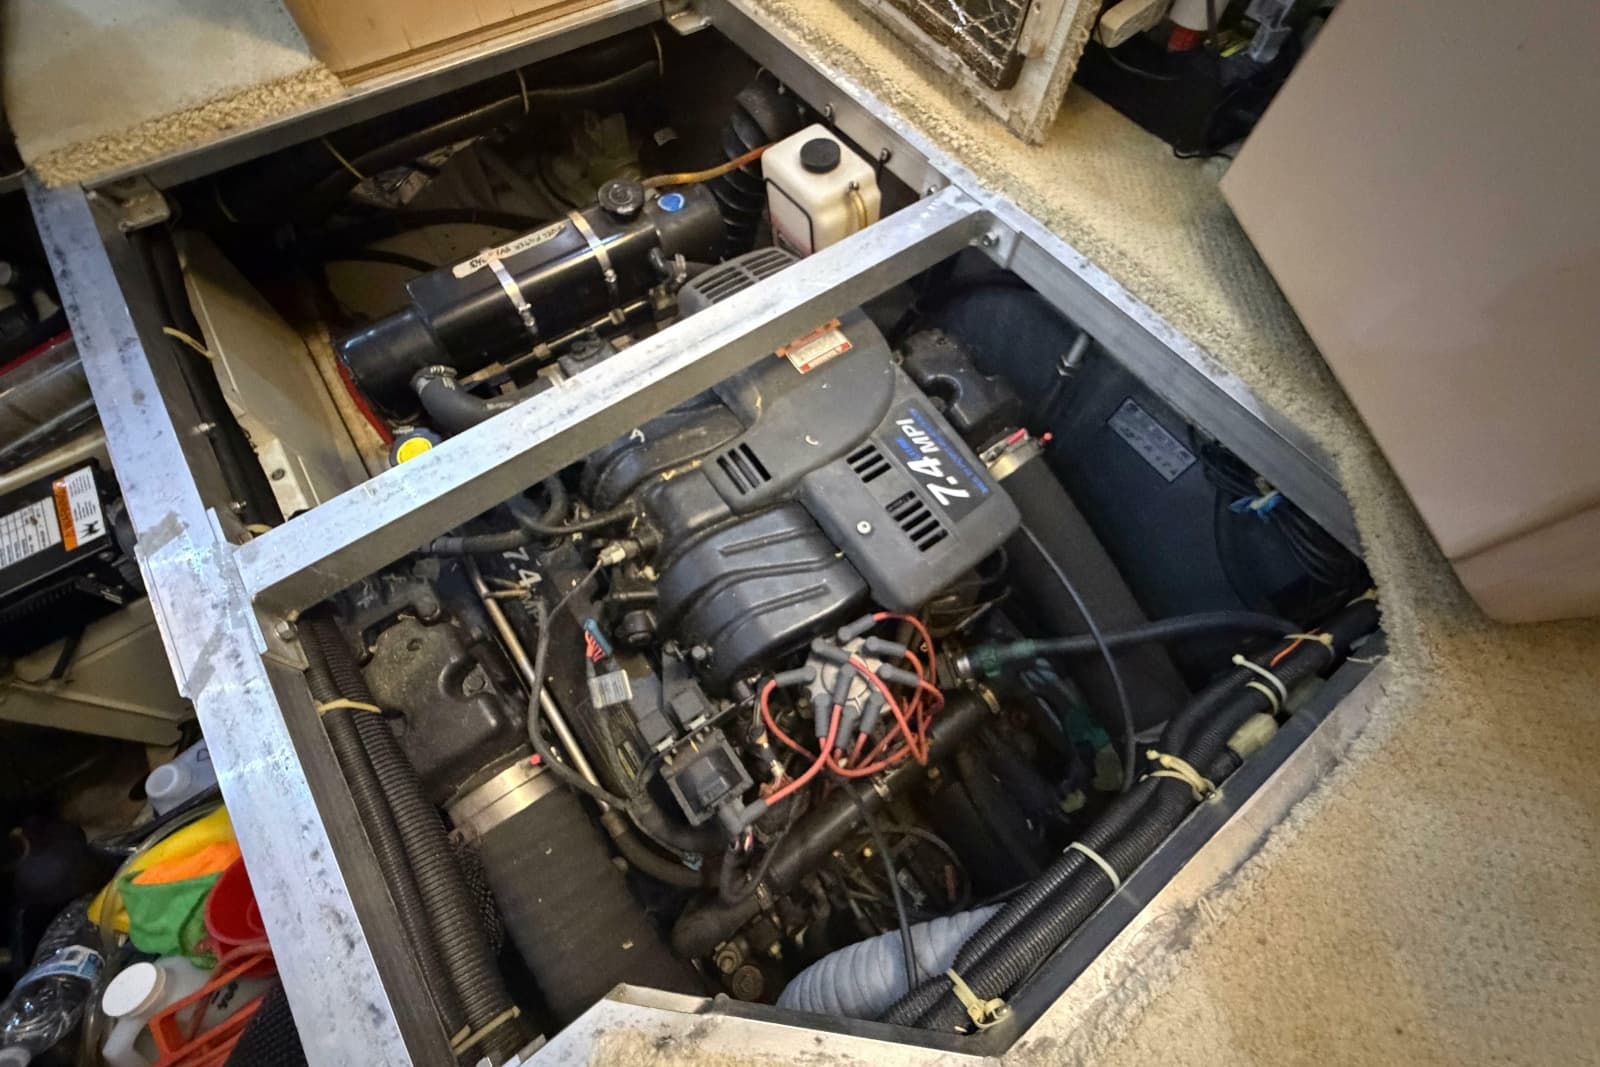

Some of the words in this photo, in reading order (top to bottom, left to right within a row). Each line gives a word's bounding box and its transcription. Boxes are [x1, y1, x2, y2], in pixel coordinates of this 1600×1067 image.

[895, 418, 940, 453] MPI
[906, 455, 971, 507] 7.4
[502, 546, 543, 588] 7.4
